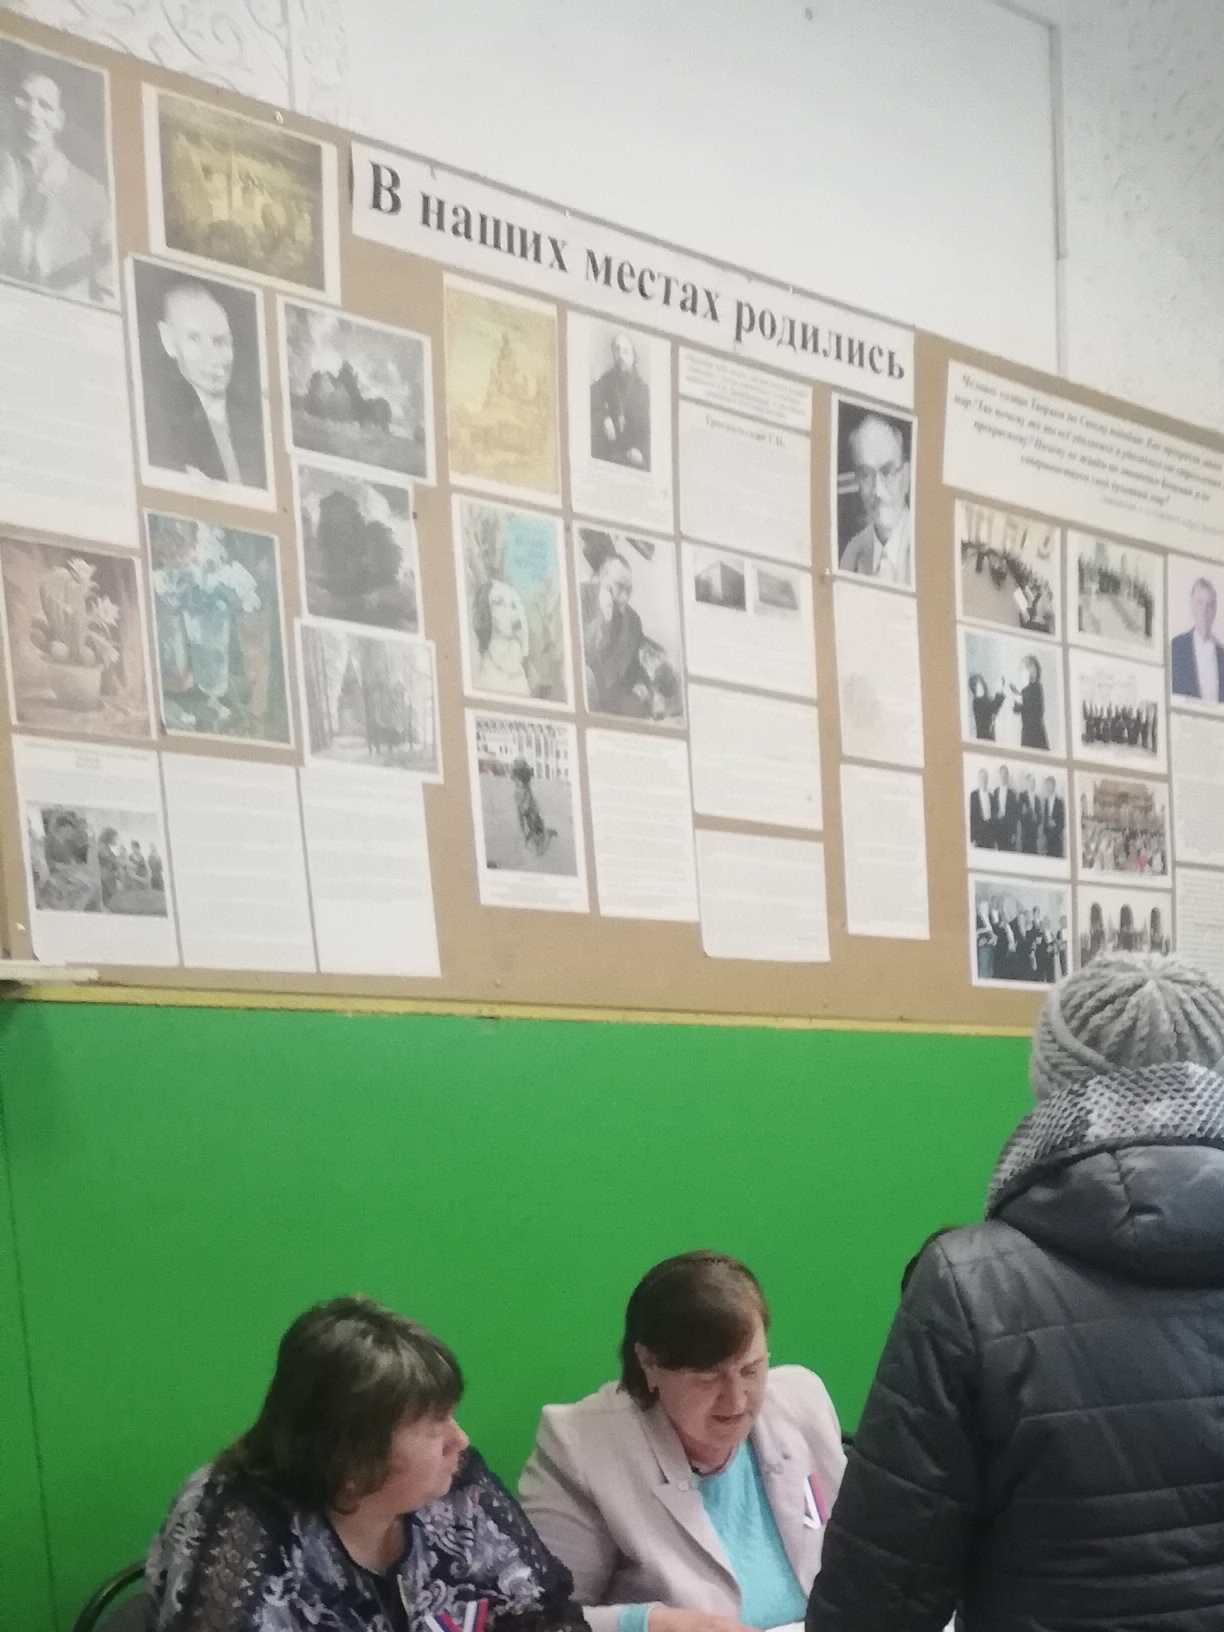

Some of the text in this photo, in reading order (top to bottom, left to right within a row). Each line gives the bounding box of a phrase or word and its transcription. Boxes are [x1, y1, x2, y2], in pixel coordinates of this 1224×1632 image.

[369, 161, 906, 381] В наших местах родились
